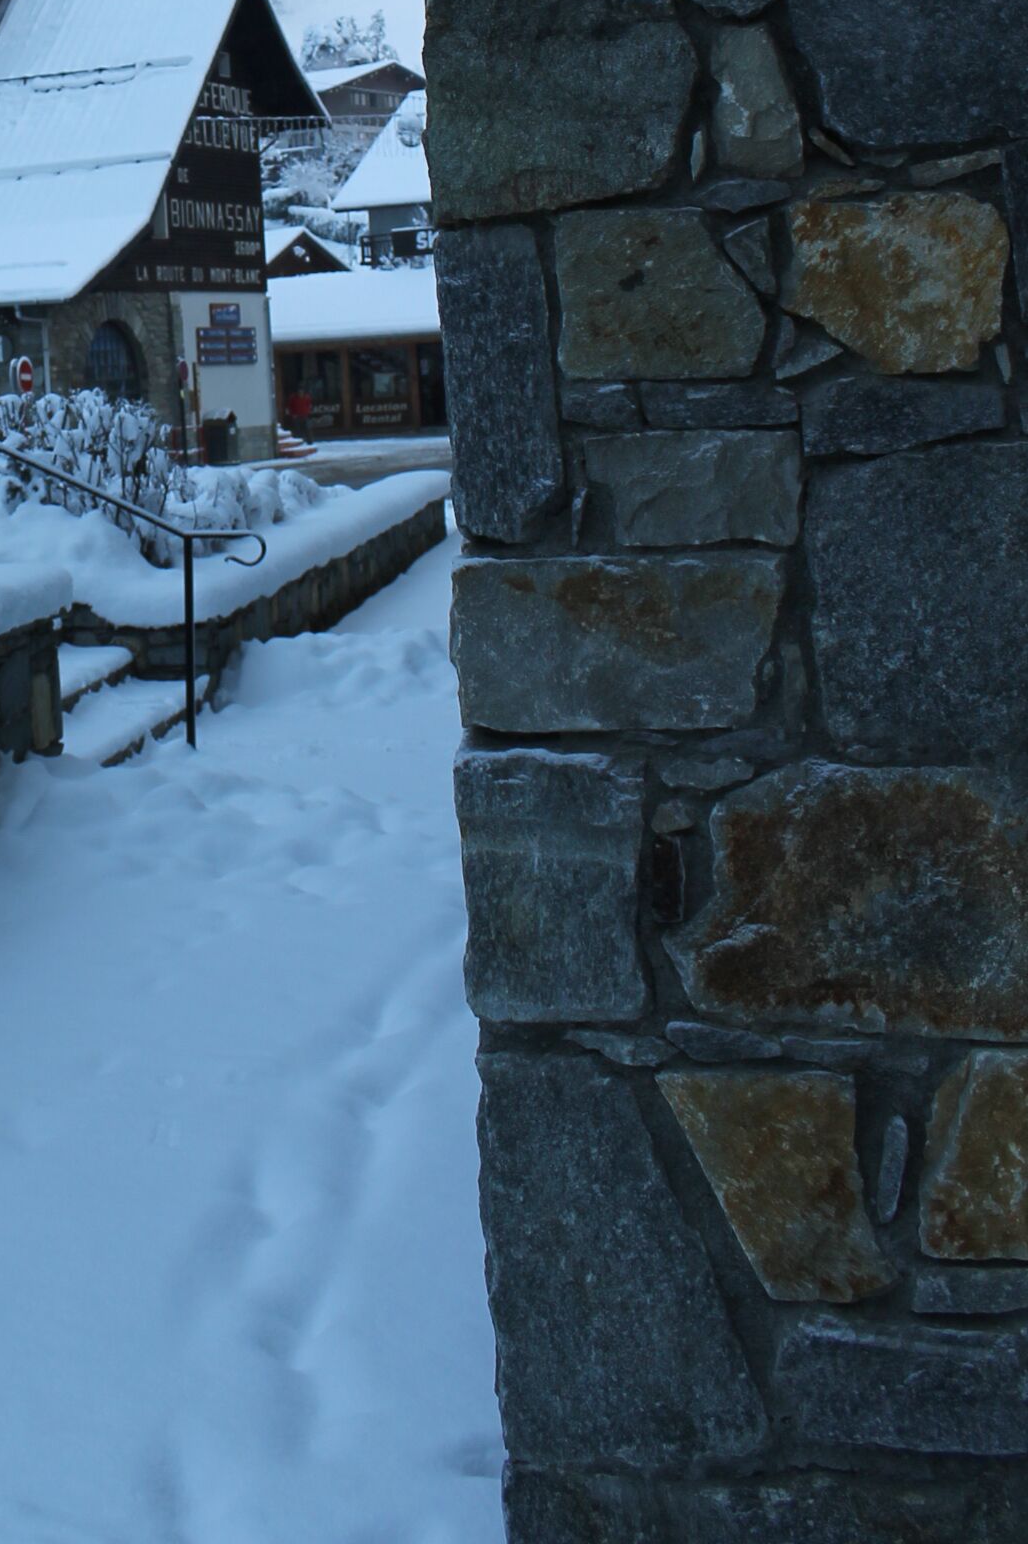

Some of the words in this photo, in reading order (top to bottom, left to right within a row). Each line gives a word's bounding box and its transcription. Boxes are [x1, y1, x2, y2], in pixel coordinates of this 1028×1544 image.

[170, 198, 261, 233] BIONNASSAY
[135, 265, 149, 282] LA
[156, 265, 186, 283] ROUTE
[356, 402, 408, 414] Location
[362, 413, 403, 424] Rental
